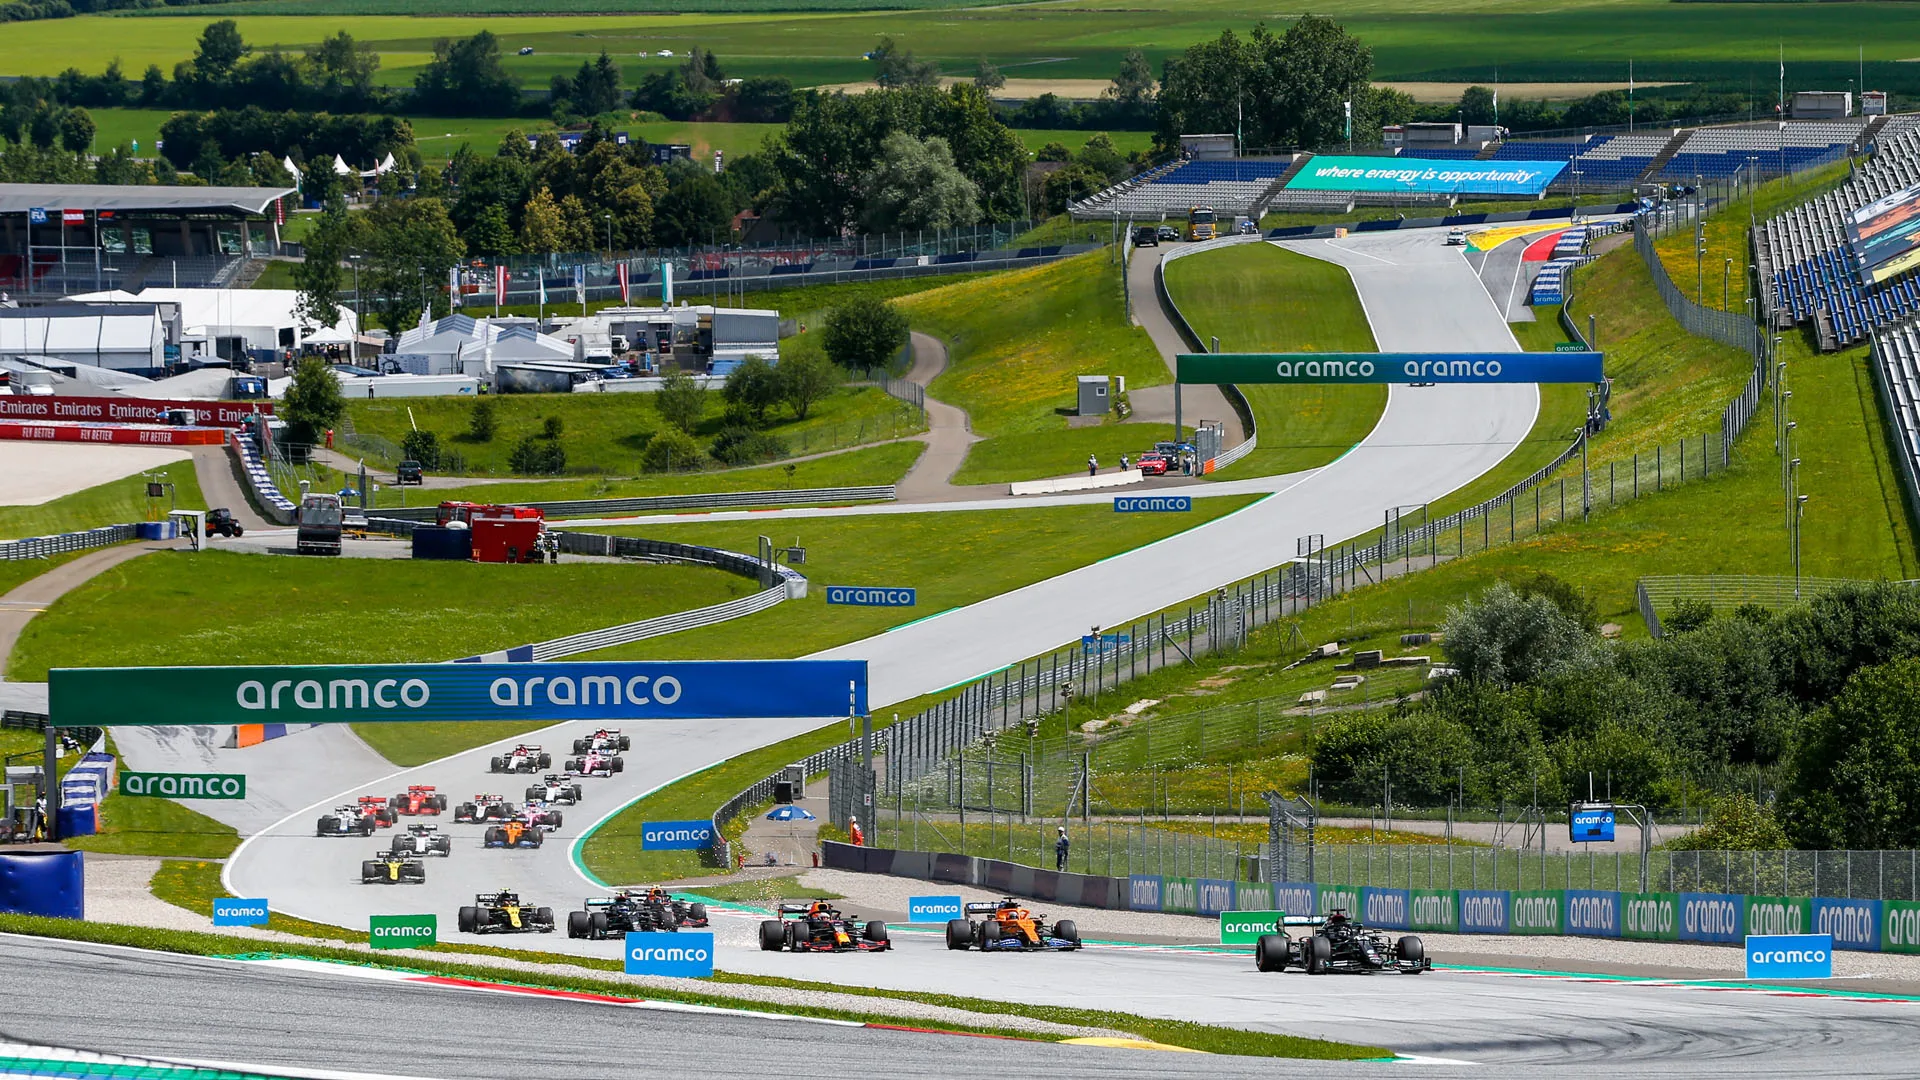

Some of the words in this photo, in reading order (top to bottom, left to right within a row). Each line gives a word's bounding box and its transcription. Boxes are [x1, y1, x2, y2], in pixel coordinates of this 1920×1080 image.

[1315, 166, 1364, 179] where
[1365, 168, 1423, 182] energy
[1421, 168, 1437, 180] is
[1438, 169, 1535, 185] opportunity
[1277, 361, 1375, 377] aramco
[1404, 360, 1502, 377] aramco
[0, 400, 48, 415] Emirates
[54, 402, 102, 416] Emirates
[109, 403, 157, 418] Emirates
[22, 427, 32, 438] FLY
[33, 427, 55, 439] BETTER
[80, 429, 91, 440] FLY
[91, 430, 113, 441] BETTER
[139, 431, 149, 442] FLY
[150, 432, 172, 443] BETTER
[1118, 499, 1187, 510] aramco
[832, 589, 910, 604] aramco
[236, 678, 430, 709] aramco
[489, 675, 682, 706] aramco
[126, 776, 240, 796] aramco
[1575, 816, 1612, 825] aramco
[646, 829, 710, 842] aramco
[1132, 880, 1159, 905] aramco
[1166, 882, 1194, 909] aramco
[1201, 884, 1230, 911] aramco
[1239, 888, 1269, 911] aramco
[1279, 888, 1312, 915] aramco
[217, 907, 264, 917] aramco
[913, 905, 958, 914] aramco
[1367, 893, 1404, 924] aramco
[1413, 896, 1452, 925] aramco
[1464, 896, 1503, 928] aramco
[1514, 897, 1557, 928] aramco
[1570, 896, 1613, 930] aramco
[1627, 900, 1672, 933] aramco
[1685, 900, 1735, 934] aramco
[1750, 903, 1801, 935] aramco
[374, 926, 432, 937] aramco
[1818, 906, 1872, 943] aramco
[631, 947, 707, 962] aramco
[1752, 950, 1826, 963] aramco
